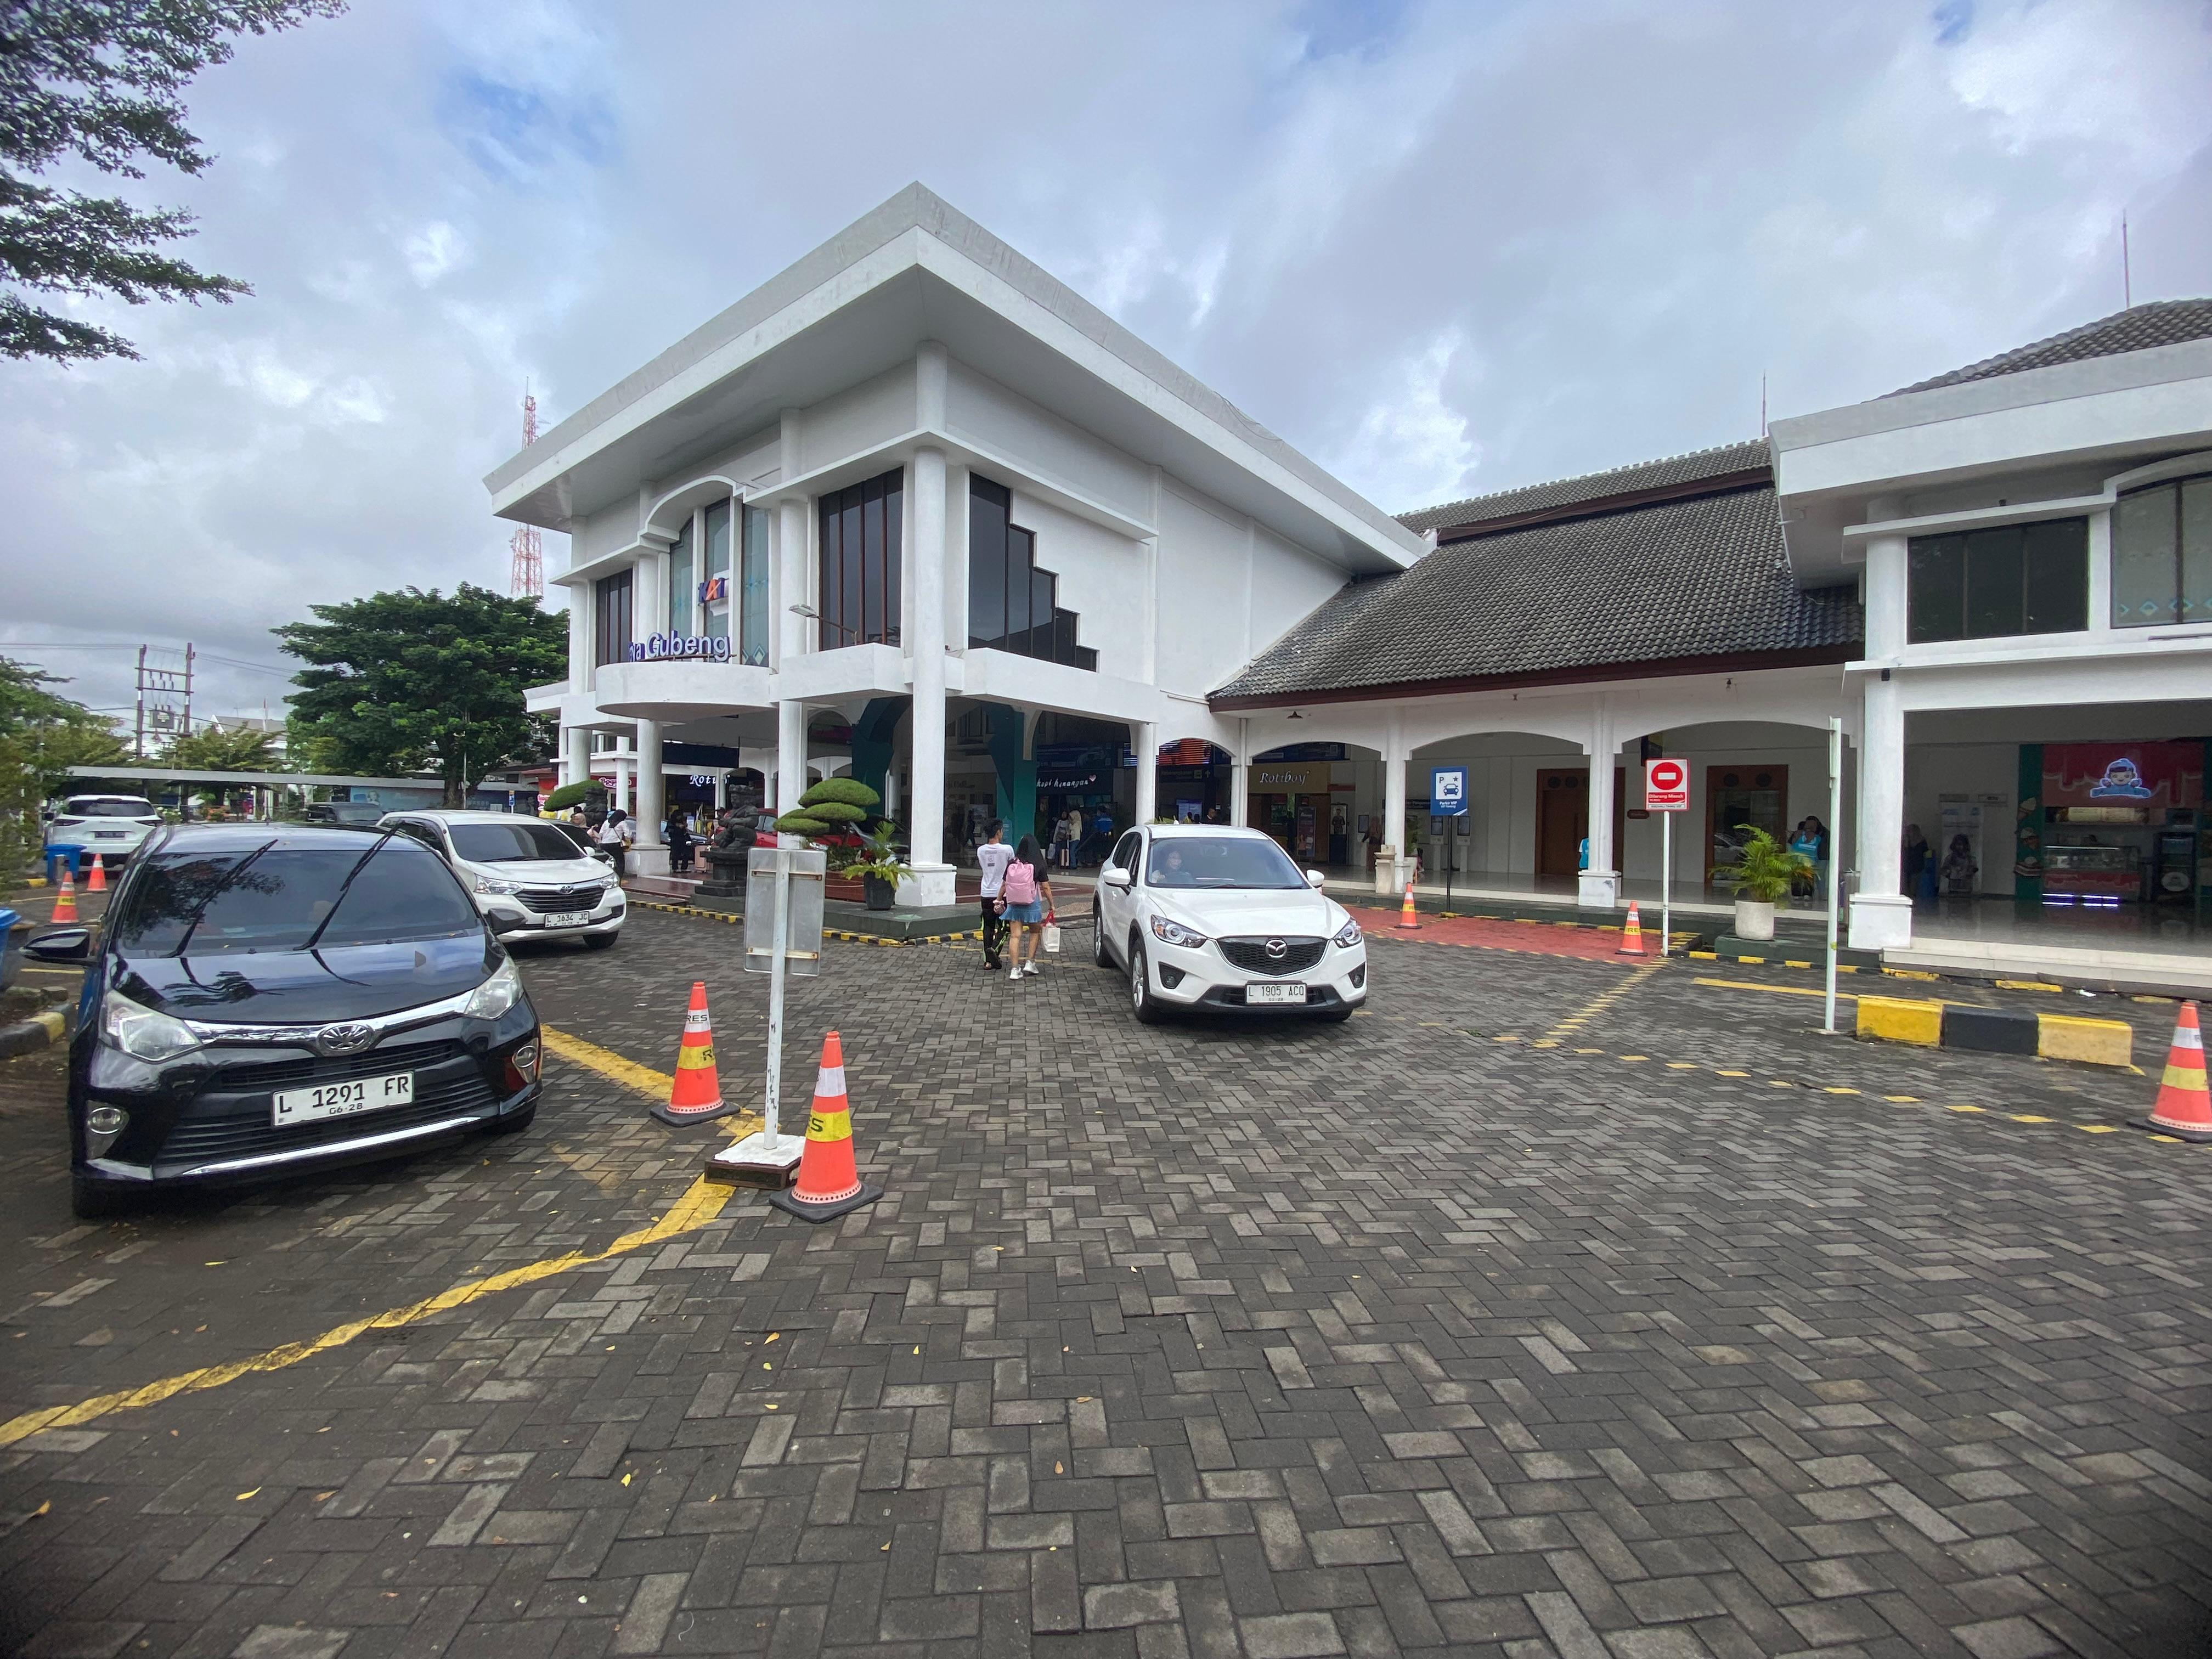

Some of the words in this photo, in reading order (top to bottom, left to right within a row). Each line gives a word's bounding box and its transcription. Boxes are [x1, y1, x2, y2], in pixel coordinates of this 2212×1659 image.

[699, 577, 725, 603] KAI
[646, 630, 730, 662] Gubeng
[1036, 777, 1052, 788] kopi
[1053, 778, 1088, 788] kenangan
[1260, 771, 1306, 786] Rotiboy
[1249, 986, 1254, 996] L
[1261, 986, 1282, 996] 1905
[279, 1096, 292, 1114] L
[312, 1083, 365, 1108] 1291
[385, 1076, 409, 1096] FR
